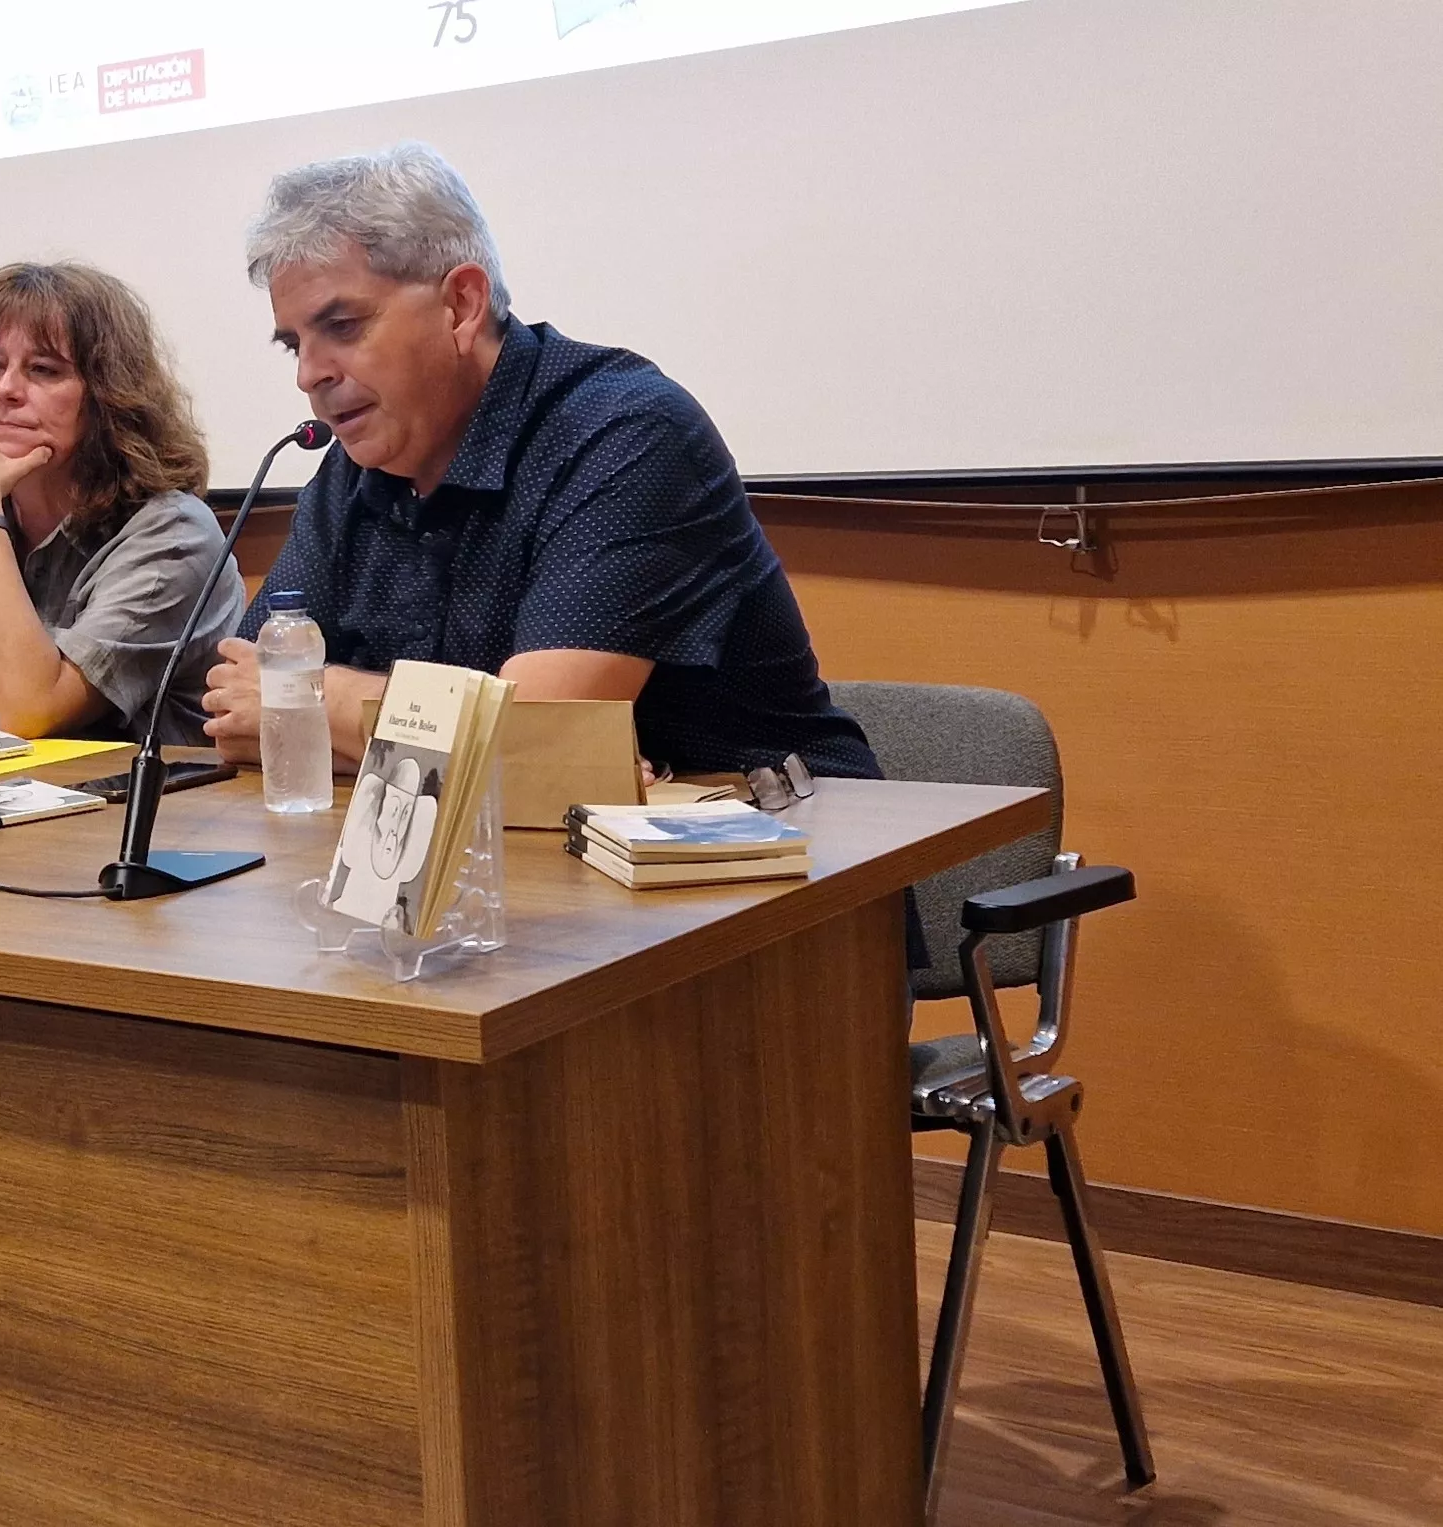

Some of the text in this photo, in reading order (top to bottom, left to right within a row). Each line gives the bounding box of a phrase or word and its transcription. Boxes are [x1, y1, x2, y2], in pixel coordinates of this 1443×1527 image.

[427, 0, 478, 47] 75
[48, 72, 85, 95] IEA
[102, 57, 192, 88] DIPUTACIÓN
[103, 90, 126, 108] DE
[408, 717, 419, 729] de
